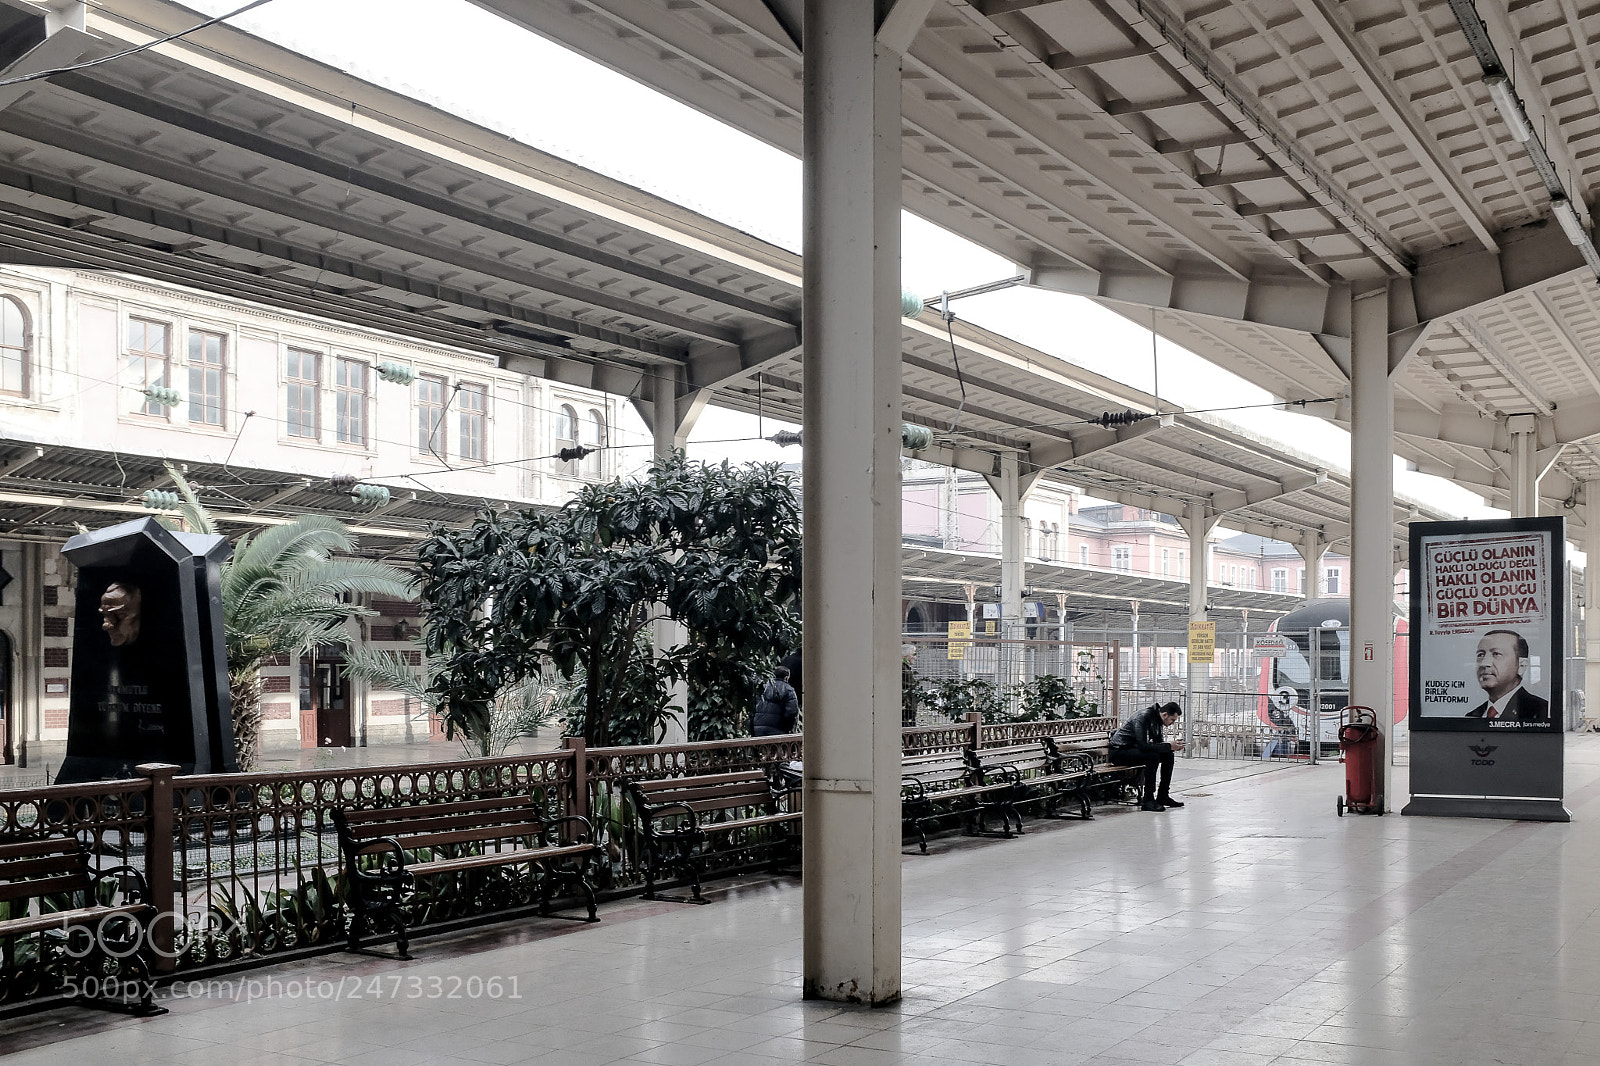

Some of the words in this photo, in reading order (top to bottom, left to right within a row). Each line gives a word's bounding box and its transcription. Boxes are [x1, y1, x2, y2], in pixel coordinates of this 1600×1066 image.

[1434, 549, 1478, 563] GÜÇLÜ
[1482, 545, 1535, 560] OLANIN
[1435, 564, 1463, 574] HAKLI
[1436, 573, 1477, 587] HAKLI
[1480, 569, 1536, 584] OLANIN
[1436, 586, 1478, 600] GÜÇLÜ
[1437, 601, 1469, 618] BİR
[1473, 597, 1539, 617] DÜNYA
[1425, 680, 1450, 688] KUDÜS
[1279, 690, 1290, 704] 3
[1425, 695, 1469, 703] PLATFORMU
